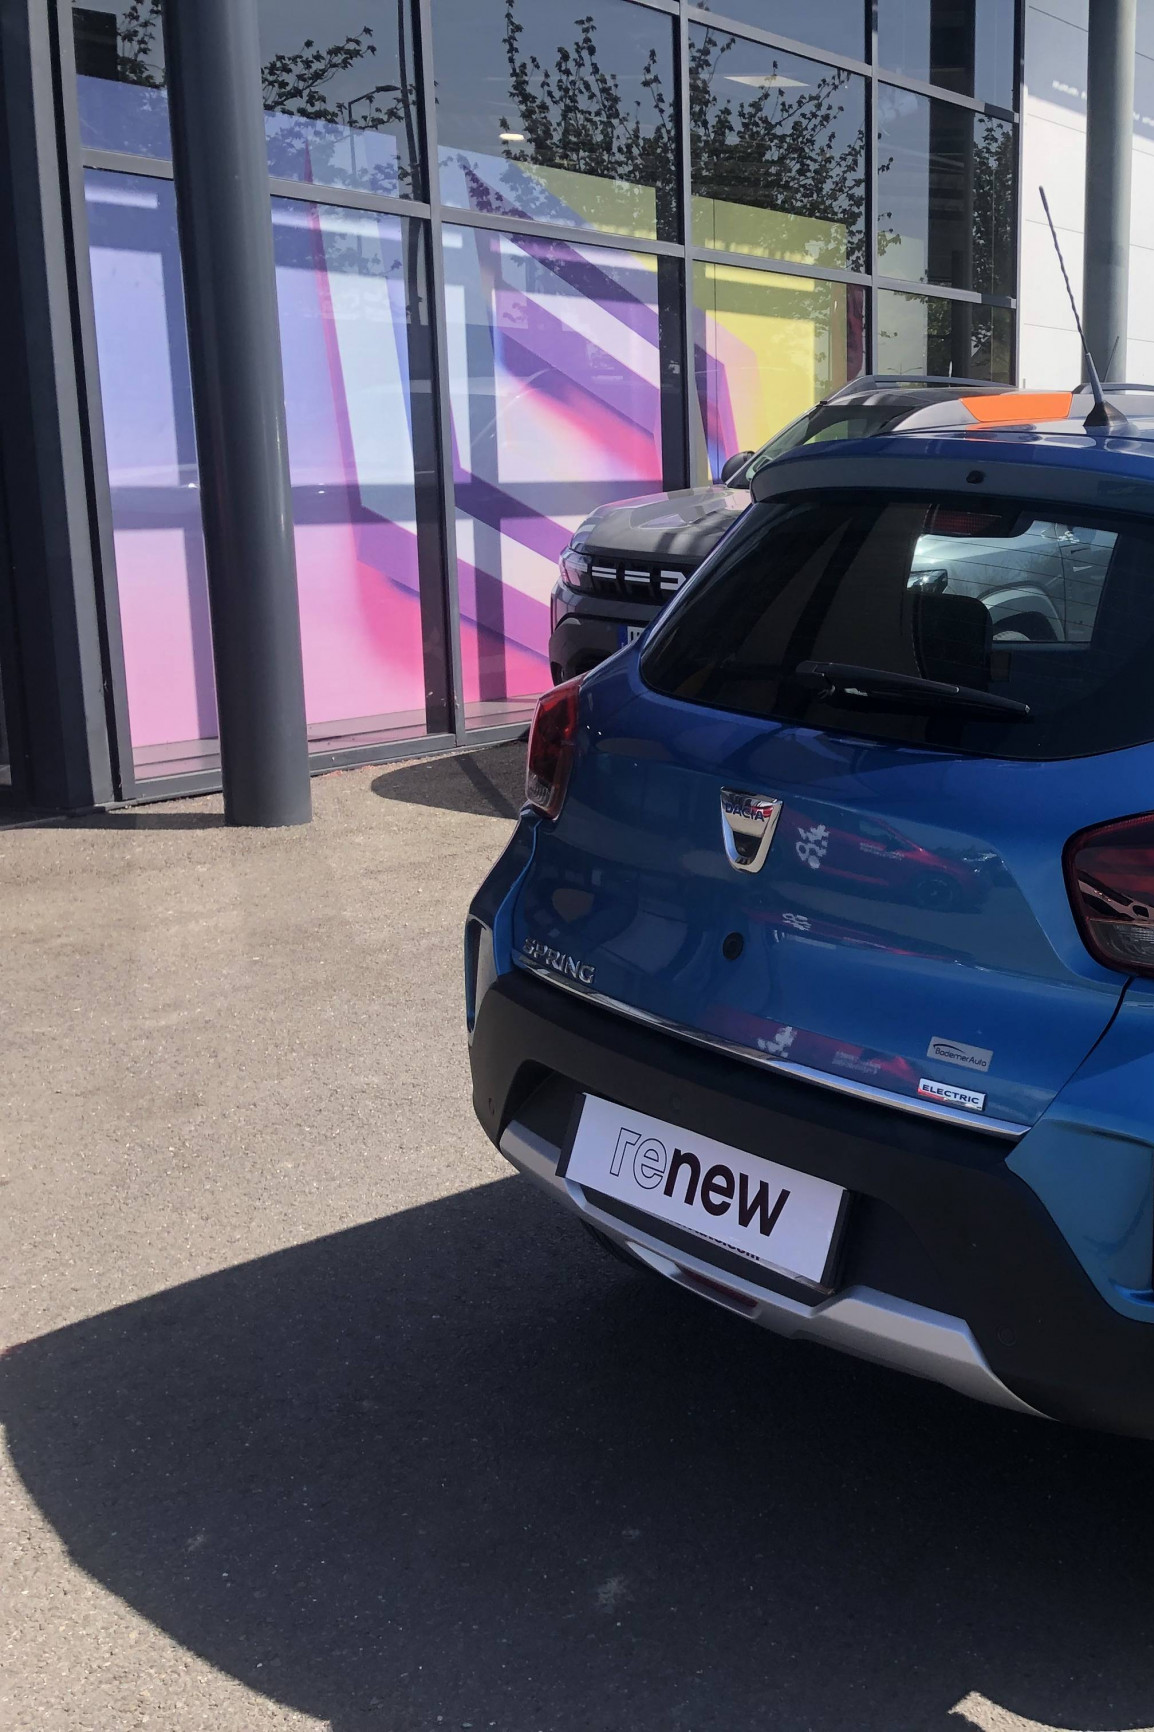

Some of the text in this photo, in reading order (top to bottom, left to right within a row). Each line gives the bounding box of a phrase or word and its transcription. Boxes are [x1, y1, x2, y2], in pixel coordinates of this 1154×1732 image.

[725, 801, 765, 822] DACIA
[522, 936, 596, 985] SPRING
[922, 1084, 980, 1104] ELECTRIC
[609, 1126, 791, 1237] renew
